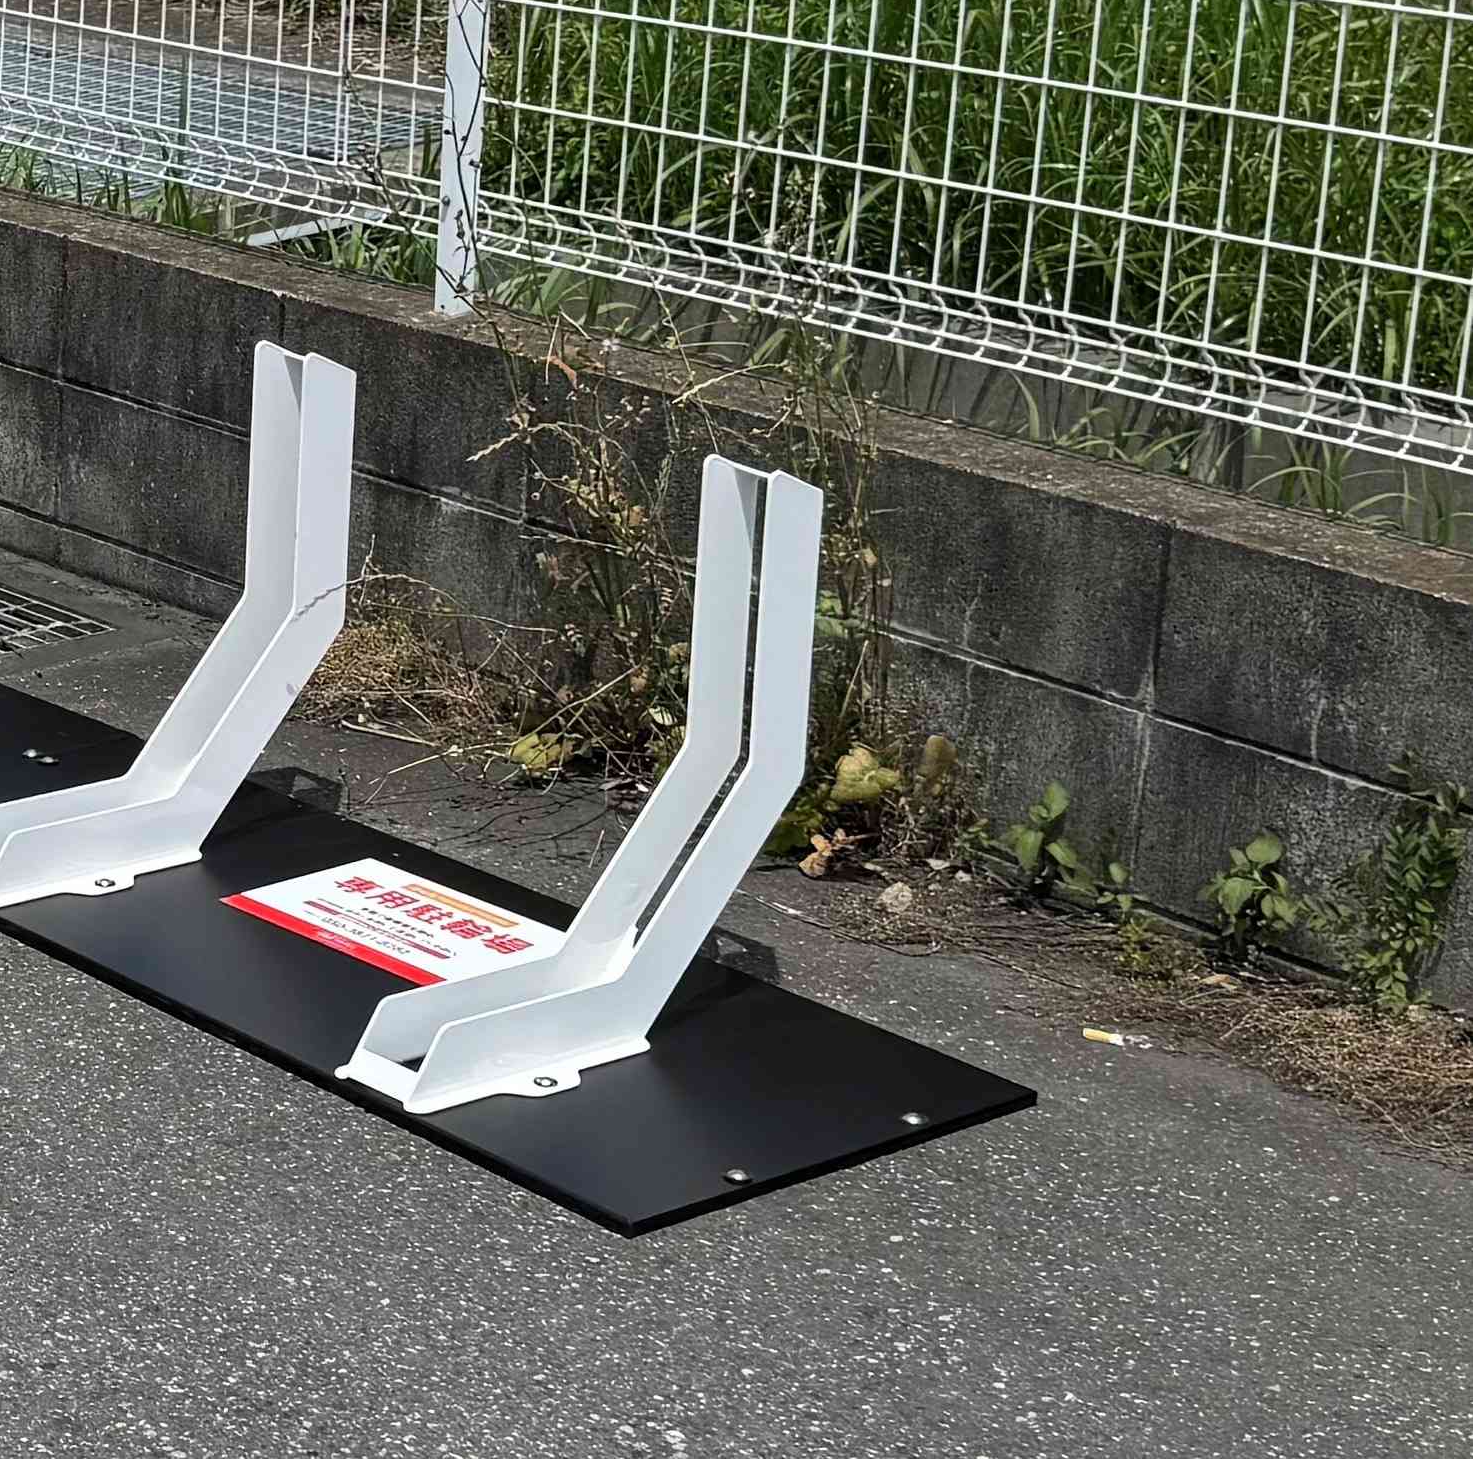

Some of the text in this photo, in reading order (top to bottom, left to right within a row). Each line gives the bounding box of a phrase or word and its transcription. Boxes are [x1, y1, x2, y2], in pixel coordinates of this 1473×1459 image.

[333, 876, 535, 955] 専用駐輪場
